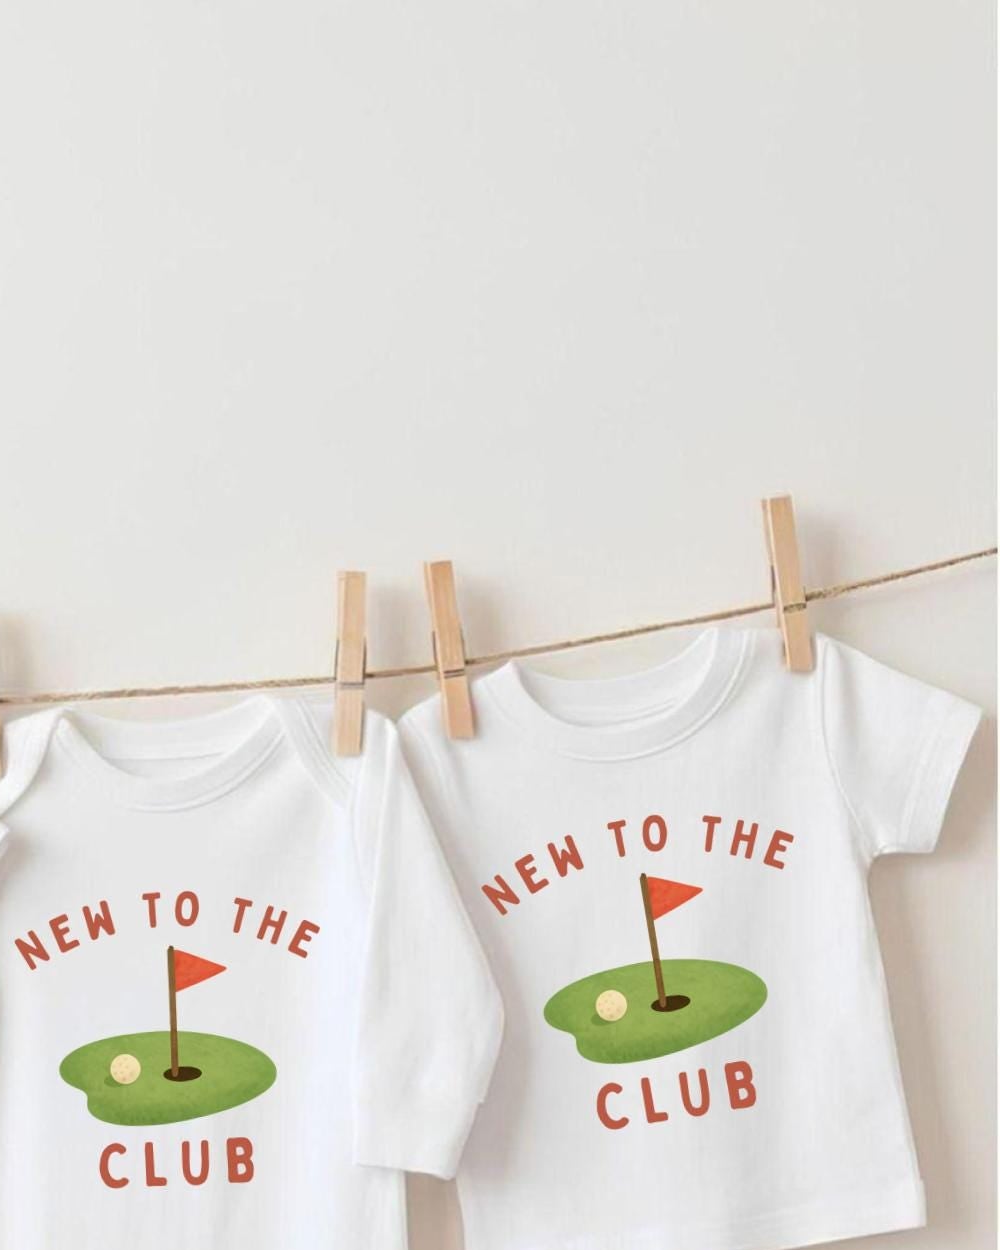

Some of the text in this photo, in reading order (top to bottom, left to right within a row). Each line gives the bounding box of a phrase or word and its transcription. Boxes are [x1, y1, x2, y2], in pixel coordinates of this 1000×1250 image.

[483, 815, 793, 913] NEW TO THE
[14, 890, 320, 970] NEW TO THE
[596, 1060, 757, 1130] CLUB
[99, 1137, 255, 1189] CLUB
